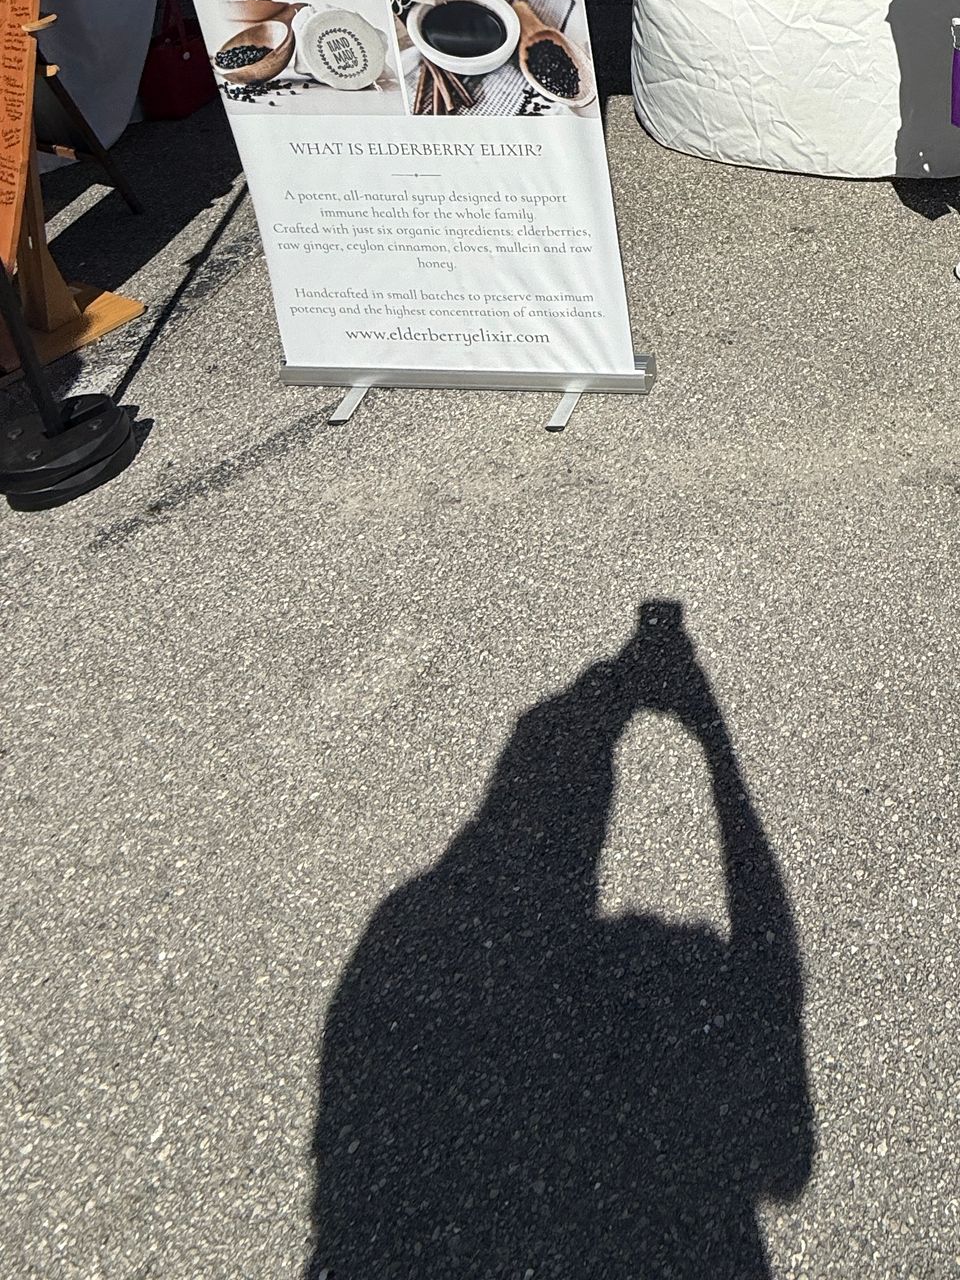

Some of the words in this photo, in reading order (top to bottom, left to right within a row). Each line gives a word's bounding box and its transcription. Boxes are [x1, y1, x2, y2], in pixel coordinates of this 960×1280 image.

[327, 37, 350, 52] HAND
[333, 48, 358, 64] MADE
[289, 142, 343, 155] WHAT
[348, 142, 364, 156] IS
[368, 142, 475, 156] ELDERBERRY
[480, 144, 543, 157] ELIXIR?
[284, 190, 296, 200] A
[297, 193, 342, 204] potent,
[343, 190, 408, 202] all-natural
[411, 194, 446, 205] syrup
[448, 191, 501, 206] designed
[505, 194, 518, 202] to
[520, 194, 567, 206] support
[320, 208, 369, 218] immune
[371, 207, 410, 219] health
[413, 208, 430, 219] for
[433, 208, 453, 219] the
[455, 208, 491, 220] whole
[273, 223, 320, 234] Crafted
[322, 223, 350, 235] with
[352, 224, 374, 237] just
[377, 225, 393, 235] six
[396, 226, 441, 239] organic
[445, 225, 514, 239] ingredients:
[517, 225, 592, 238] elderberries,
[278, 242, 301, 250] raw
[303, 241, 344, 254] ginger,
[346, 240, 385, 254] ceylon
[387, 241, 451, 254] cinnamon,
[453, 242, 493, 254] cloves,
[495, 242, 541, 253] mullein
[543, 243, 567, 253] and
[417, 257, 457, 272] honey.
[294, 287, 369, 299] Handcrafted
[371, 289, 384, 299] in
[387, 289, 417, 300] small
[420, 289, 466, 301] batches
[468, 293, 481, 301] to
[483, 293, 533, 305] preserve
[535, 292, 594, 302] maximum
[289, 305, 337, 317] potency
[339, 304, 361, 315] and
[364, 304, 383, 315] the
[385, 304, 426, 319] highest
[429, 307, 510, 317] concentration
[513, 306, 527, 317] of
[528, 307, 606, 318] antioxidants.
[345, 326, 550, 347] www.elderberryelixir.com
